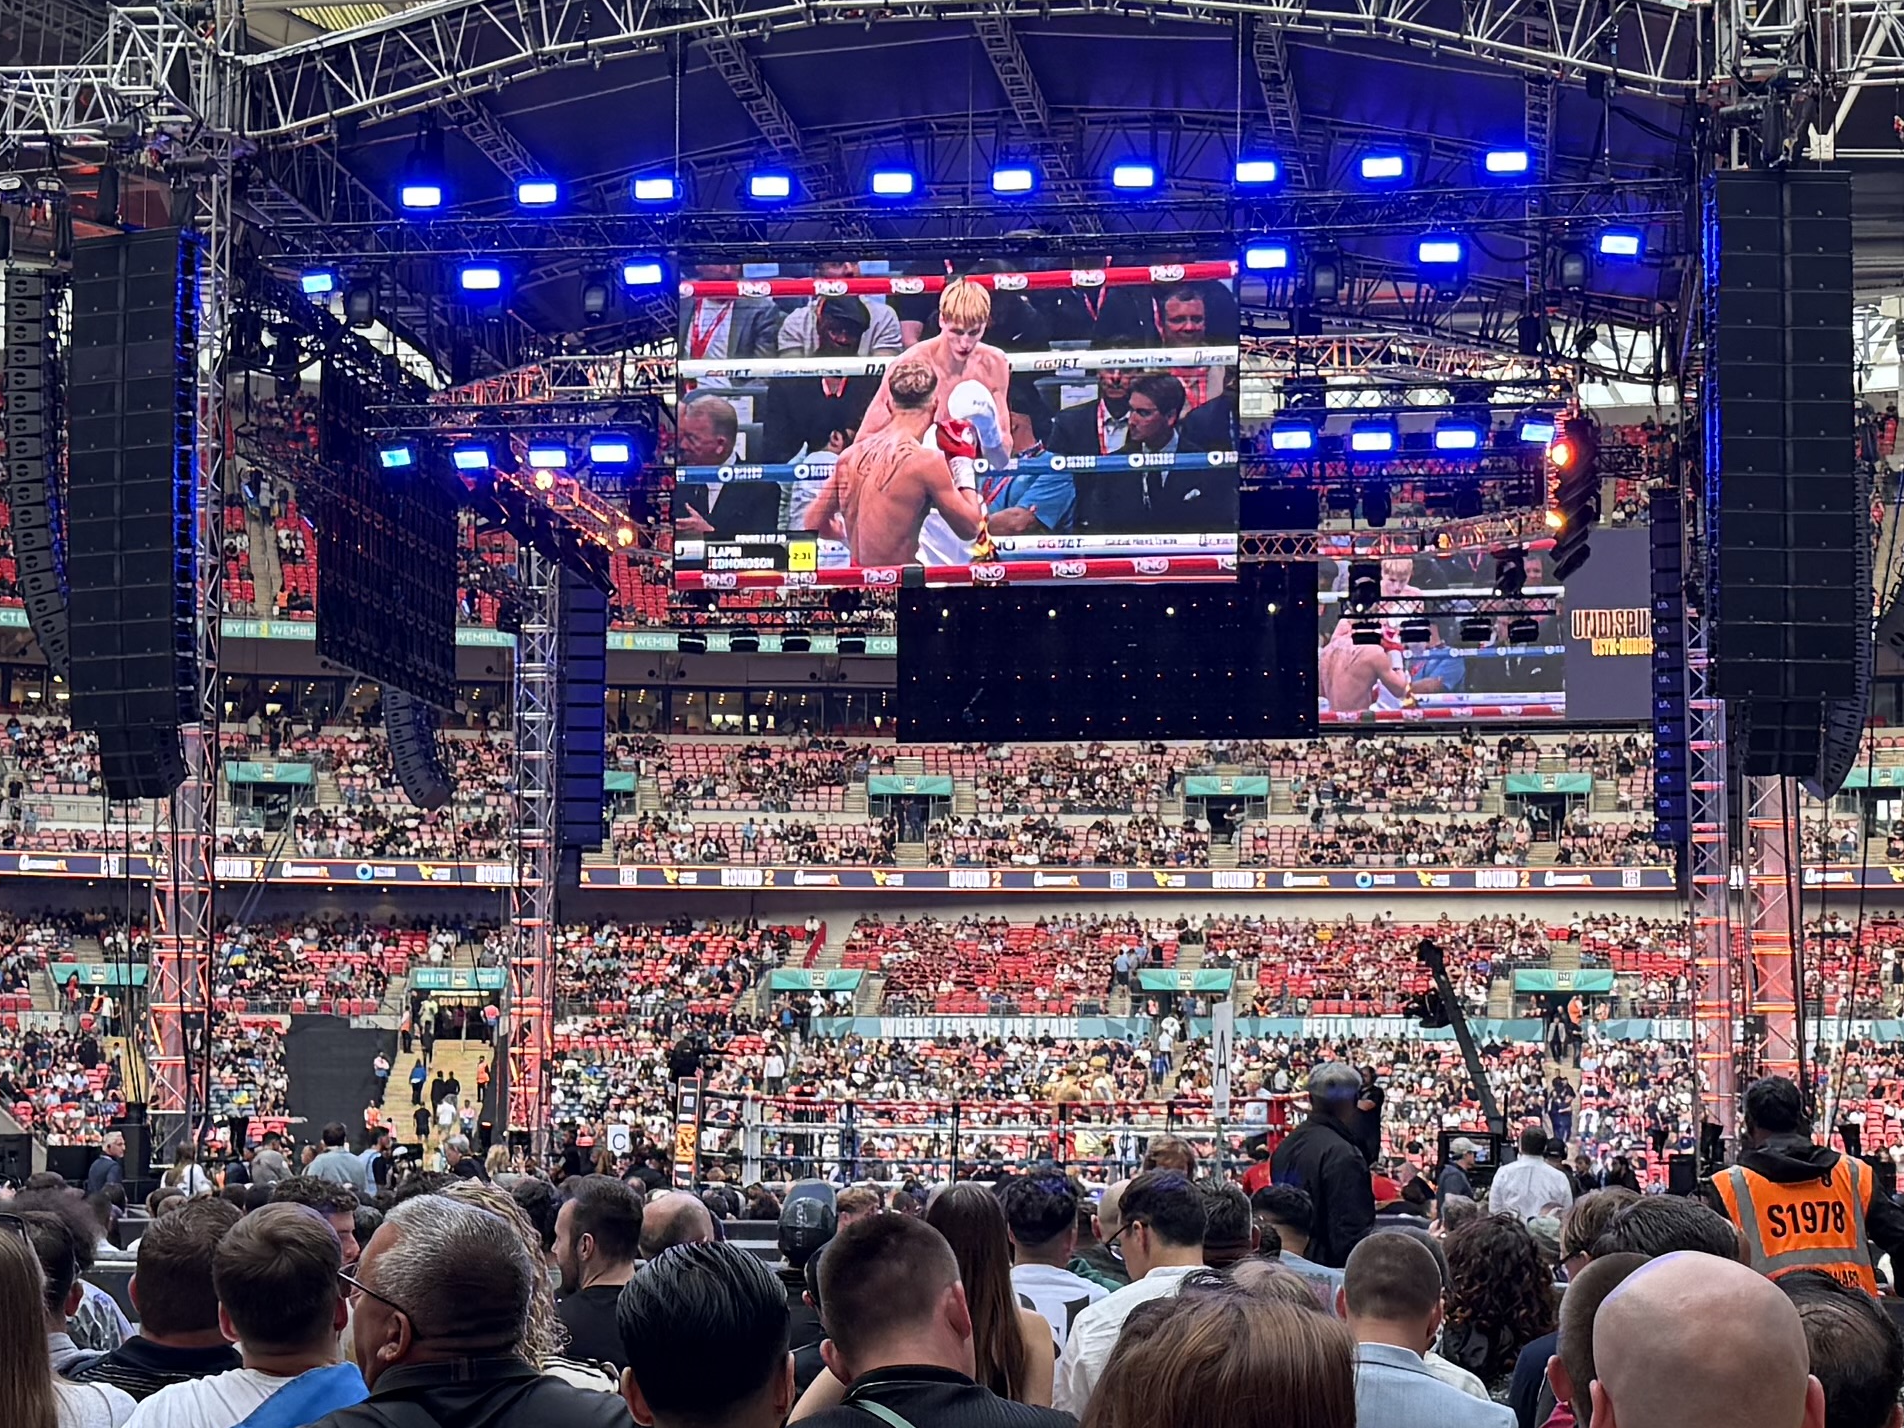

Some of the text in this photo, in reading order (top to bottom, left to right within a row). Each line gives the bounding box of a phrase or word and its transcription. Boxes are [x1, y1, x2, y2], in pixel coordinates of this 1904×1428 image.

[1571, 608, 1652, 639] UNDISPU
[1216, 1030, 1229, 1086] A
[612, 1133, 627, 1150] C
[1767, 1201, 1845, 1238] S1978
